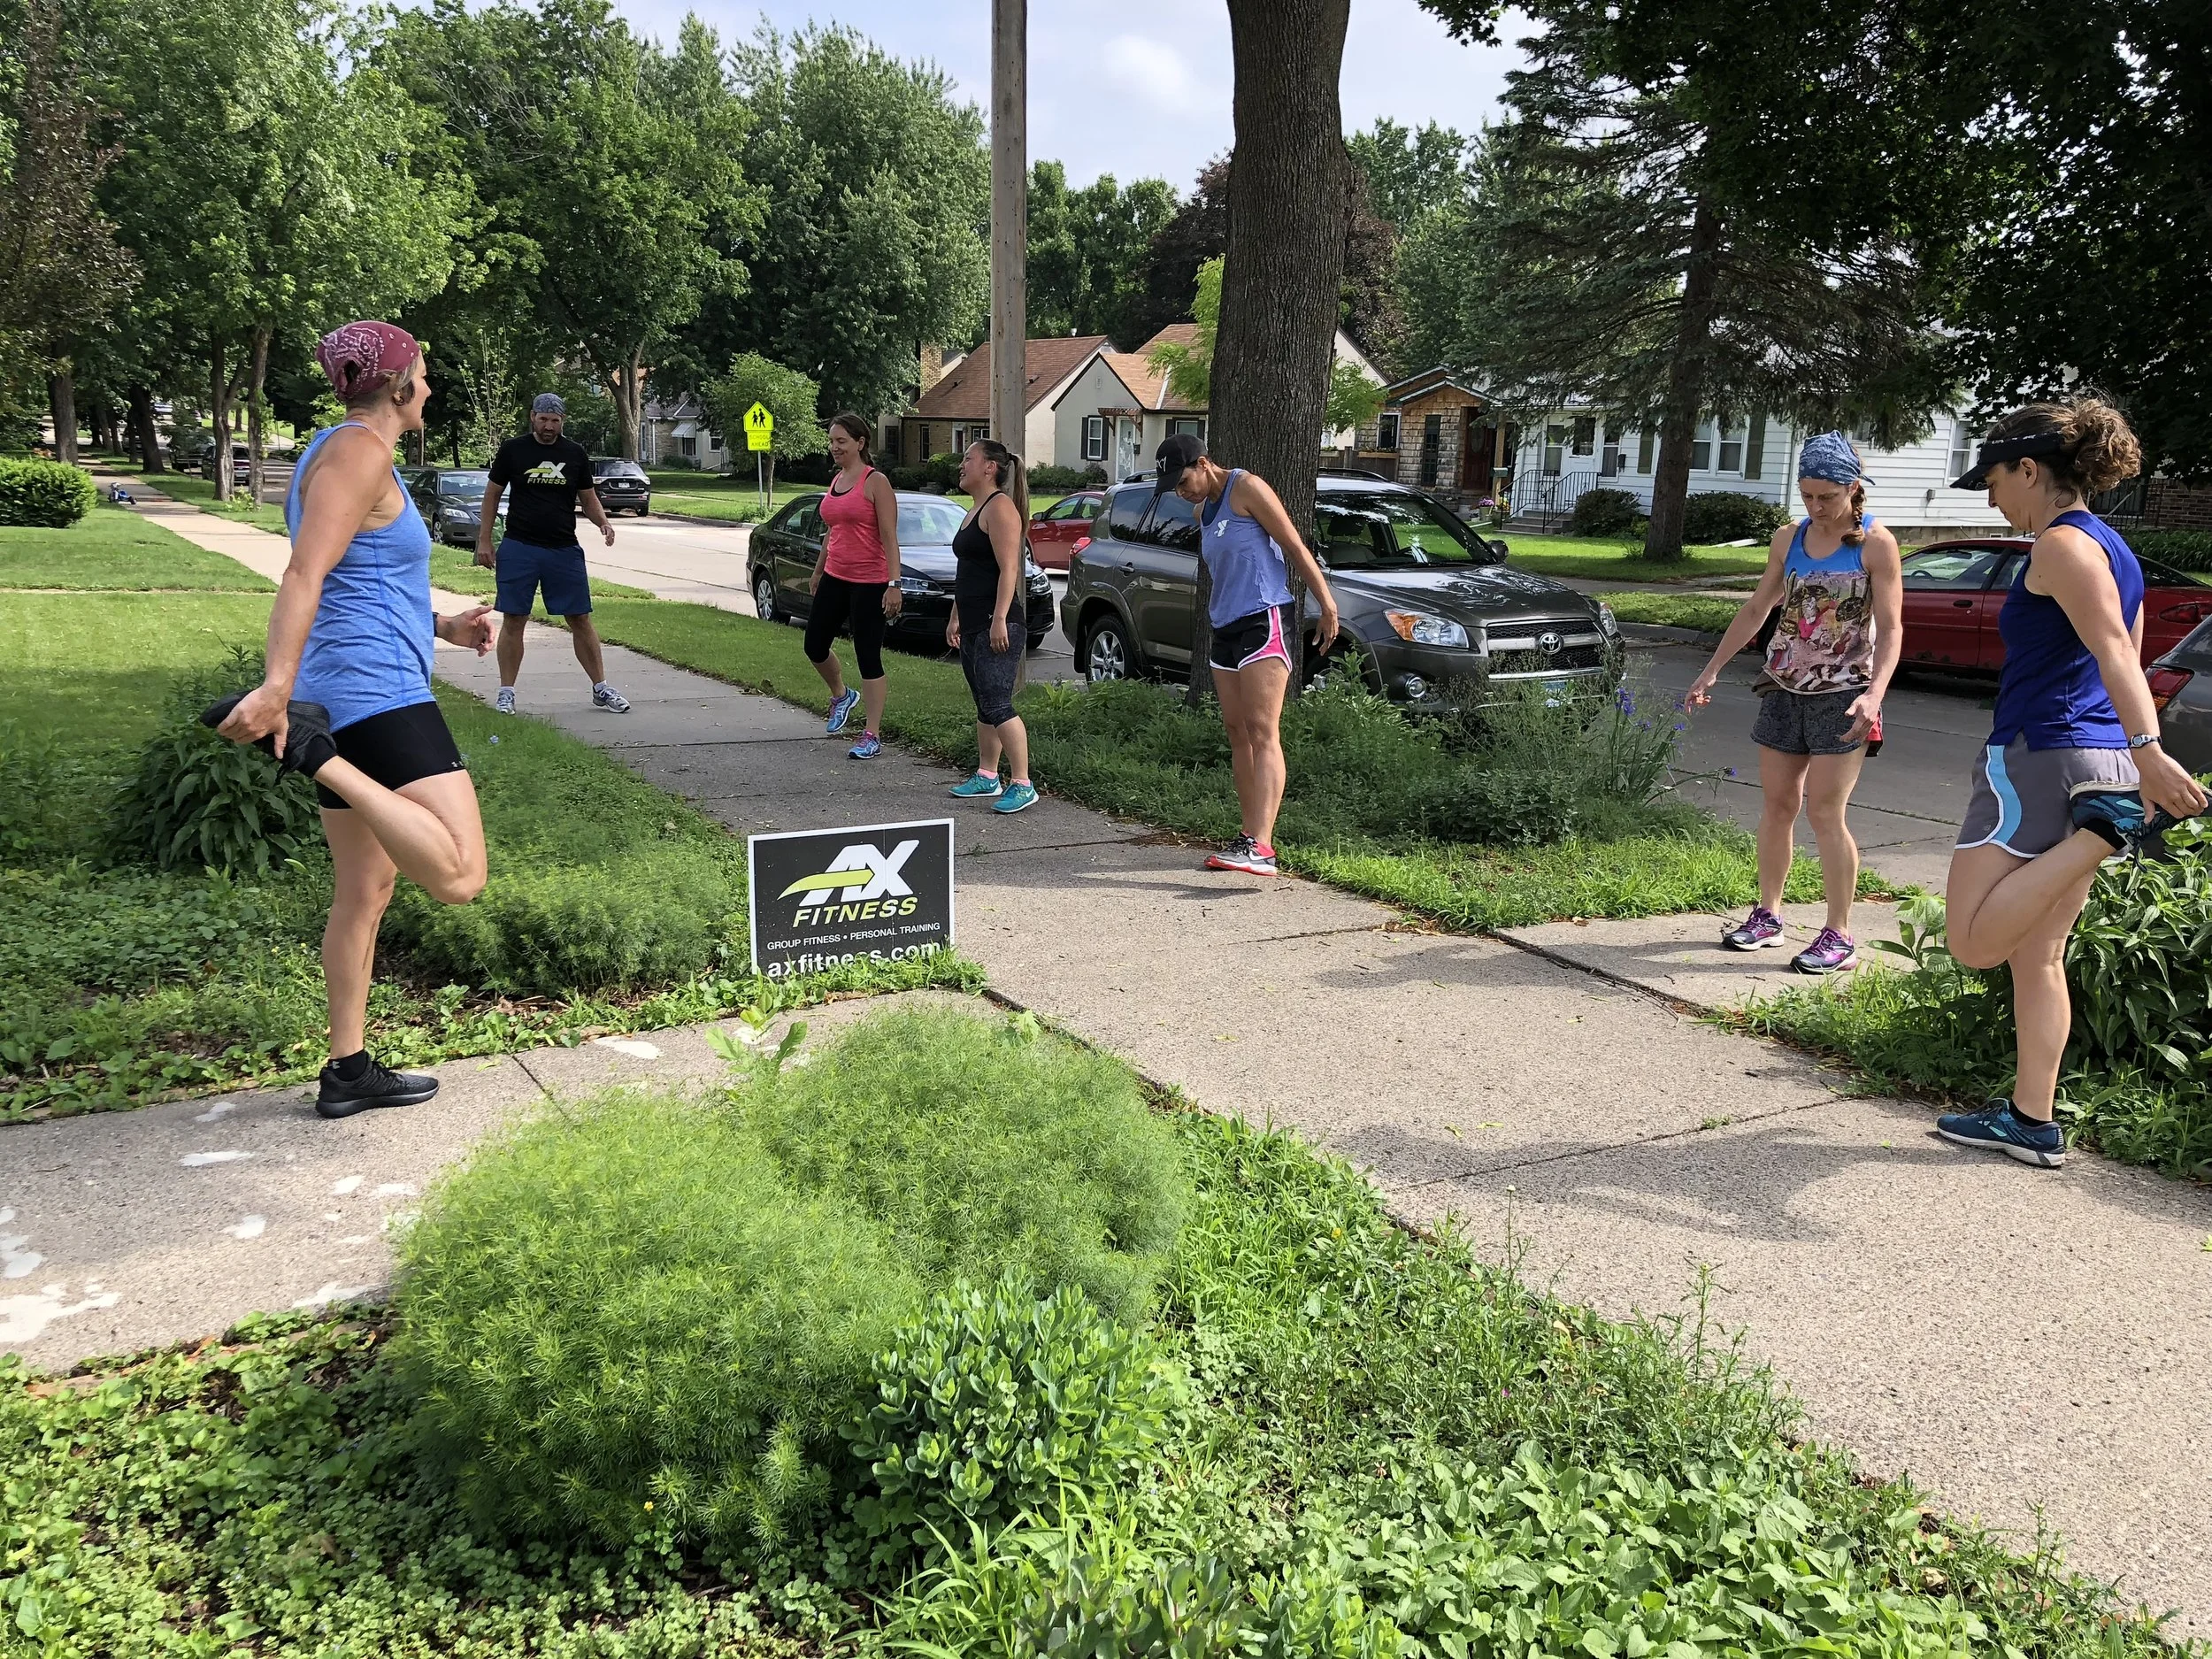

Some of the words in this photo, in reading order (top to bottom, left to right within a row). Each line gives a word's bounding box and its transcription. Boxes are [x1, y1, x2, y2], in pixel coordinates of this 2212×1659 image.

[528, 460, 566, 478] AX
[798, 839, 920, 907] AX
[792, 896, 918, 928] FITNESS
[766, 939, 802, 950] GROUP
[803, 933, 841, 947] FITNESS
[849, 927, 898, 941] PERSONAL
[899, 922, 941, 934] TRAINING
[767, 941, 941, 978] axfitnescom
